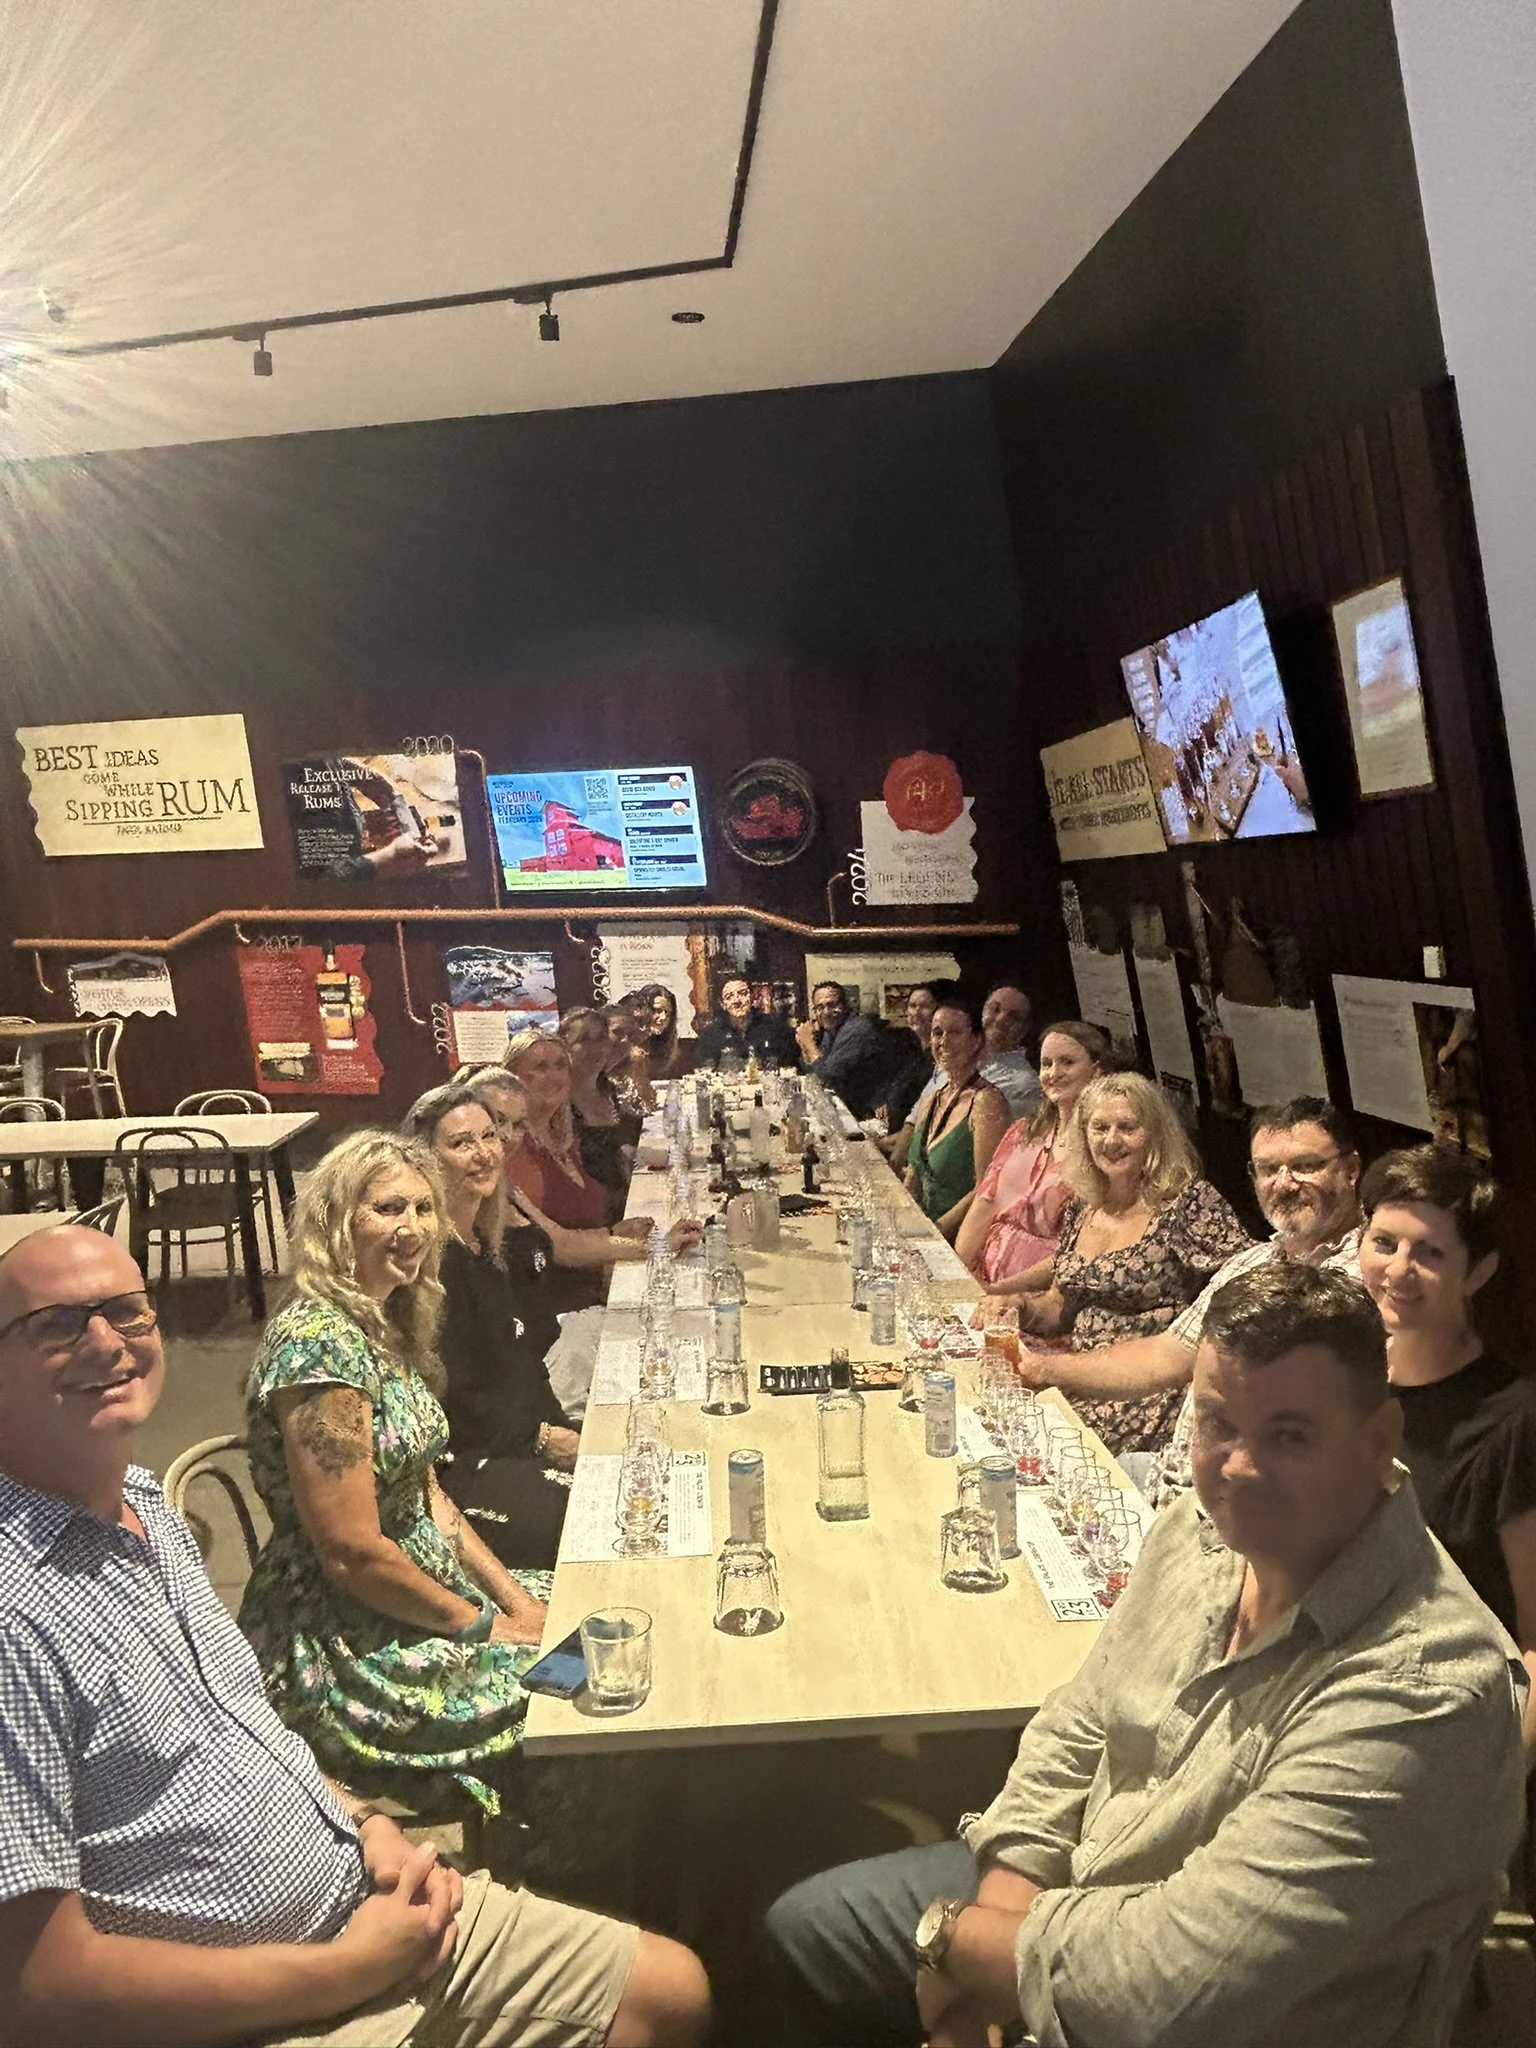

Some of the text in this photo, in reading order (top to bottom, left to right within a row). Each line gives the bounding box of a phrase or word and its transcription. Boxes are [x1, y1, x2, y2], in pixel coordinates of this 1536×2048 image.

[402, 734, 454, 757] 2020
[34, 745, 160, 772] BEST IDEAS
[83, 772, 120, 785] COME
[304, 767, 374, 783] EXCLUSIVE
[105, 782, 155, 797] WHILE
[156, 778, 250, 817] RUM
[494, 790, 542, 804] UPCOMING
[305, 794, 343, 809] RUMS
[496, 803, 532, 816] EVENTS
[847, 848, 869, 905] 2024
[1062, 1600, 1092, 1617] 23
